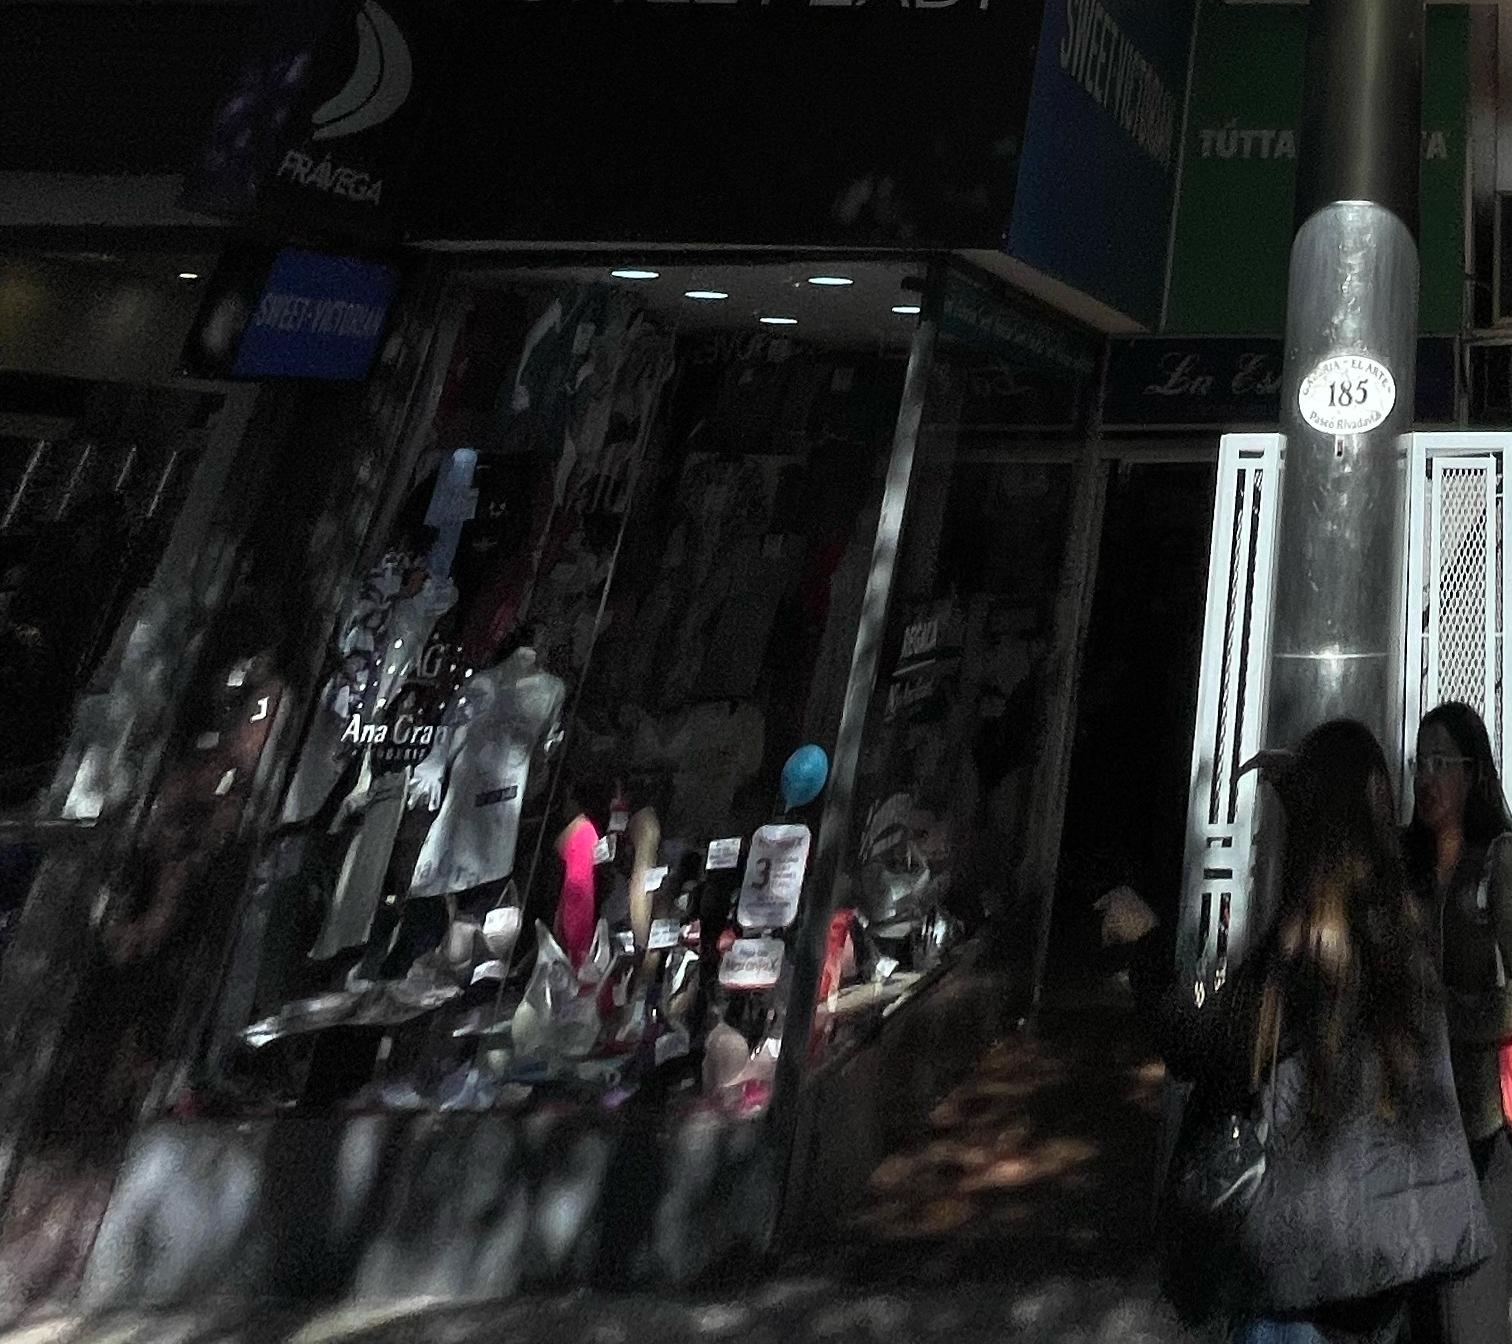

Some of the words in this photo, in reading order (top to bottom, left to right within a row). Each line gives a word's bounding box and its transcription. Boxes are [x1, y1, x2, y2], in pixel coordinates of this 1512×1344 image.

[1303, 360, 1340, 395] GARIA
[1328, 378, 1369, 407] 185
[340, 712, 389, 744] Ana
[393, 714, 452, 746] Gran
